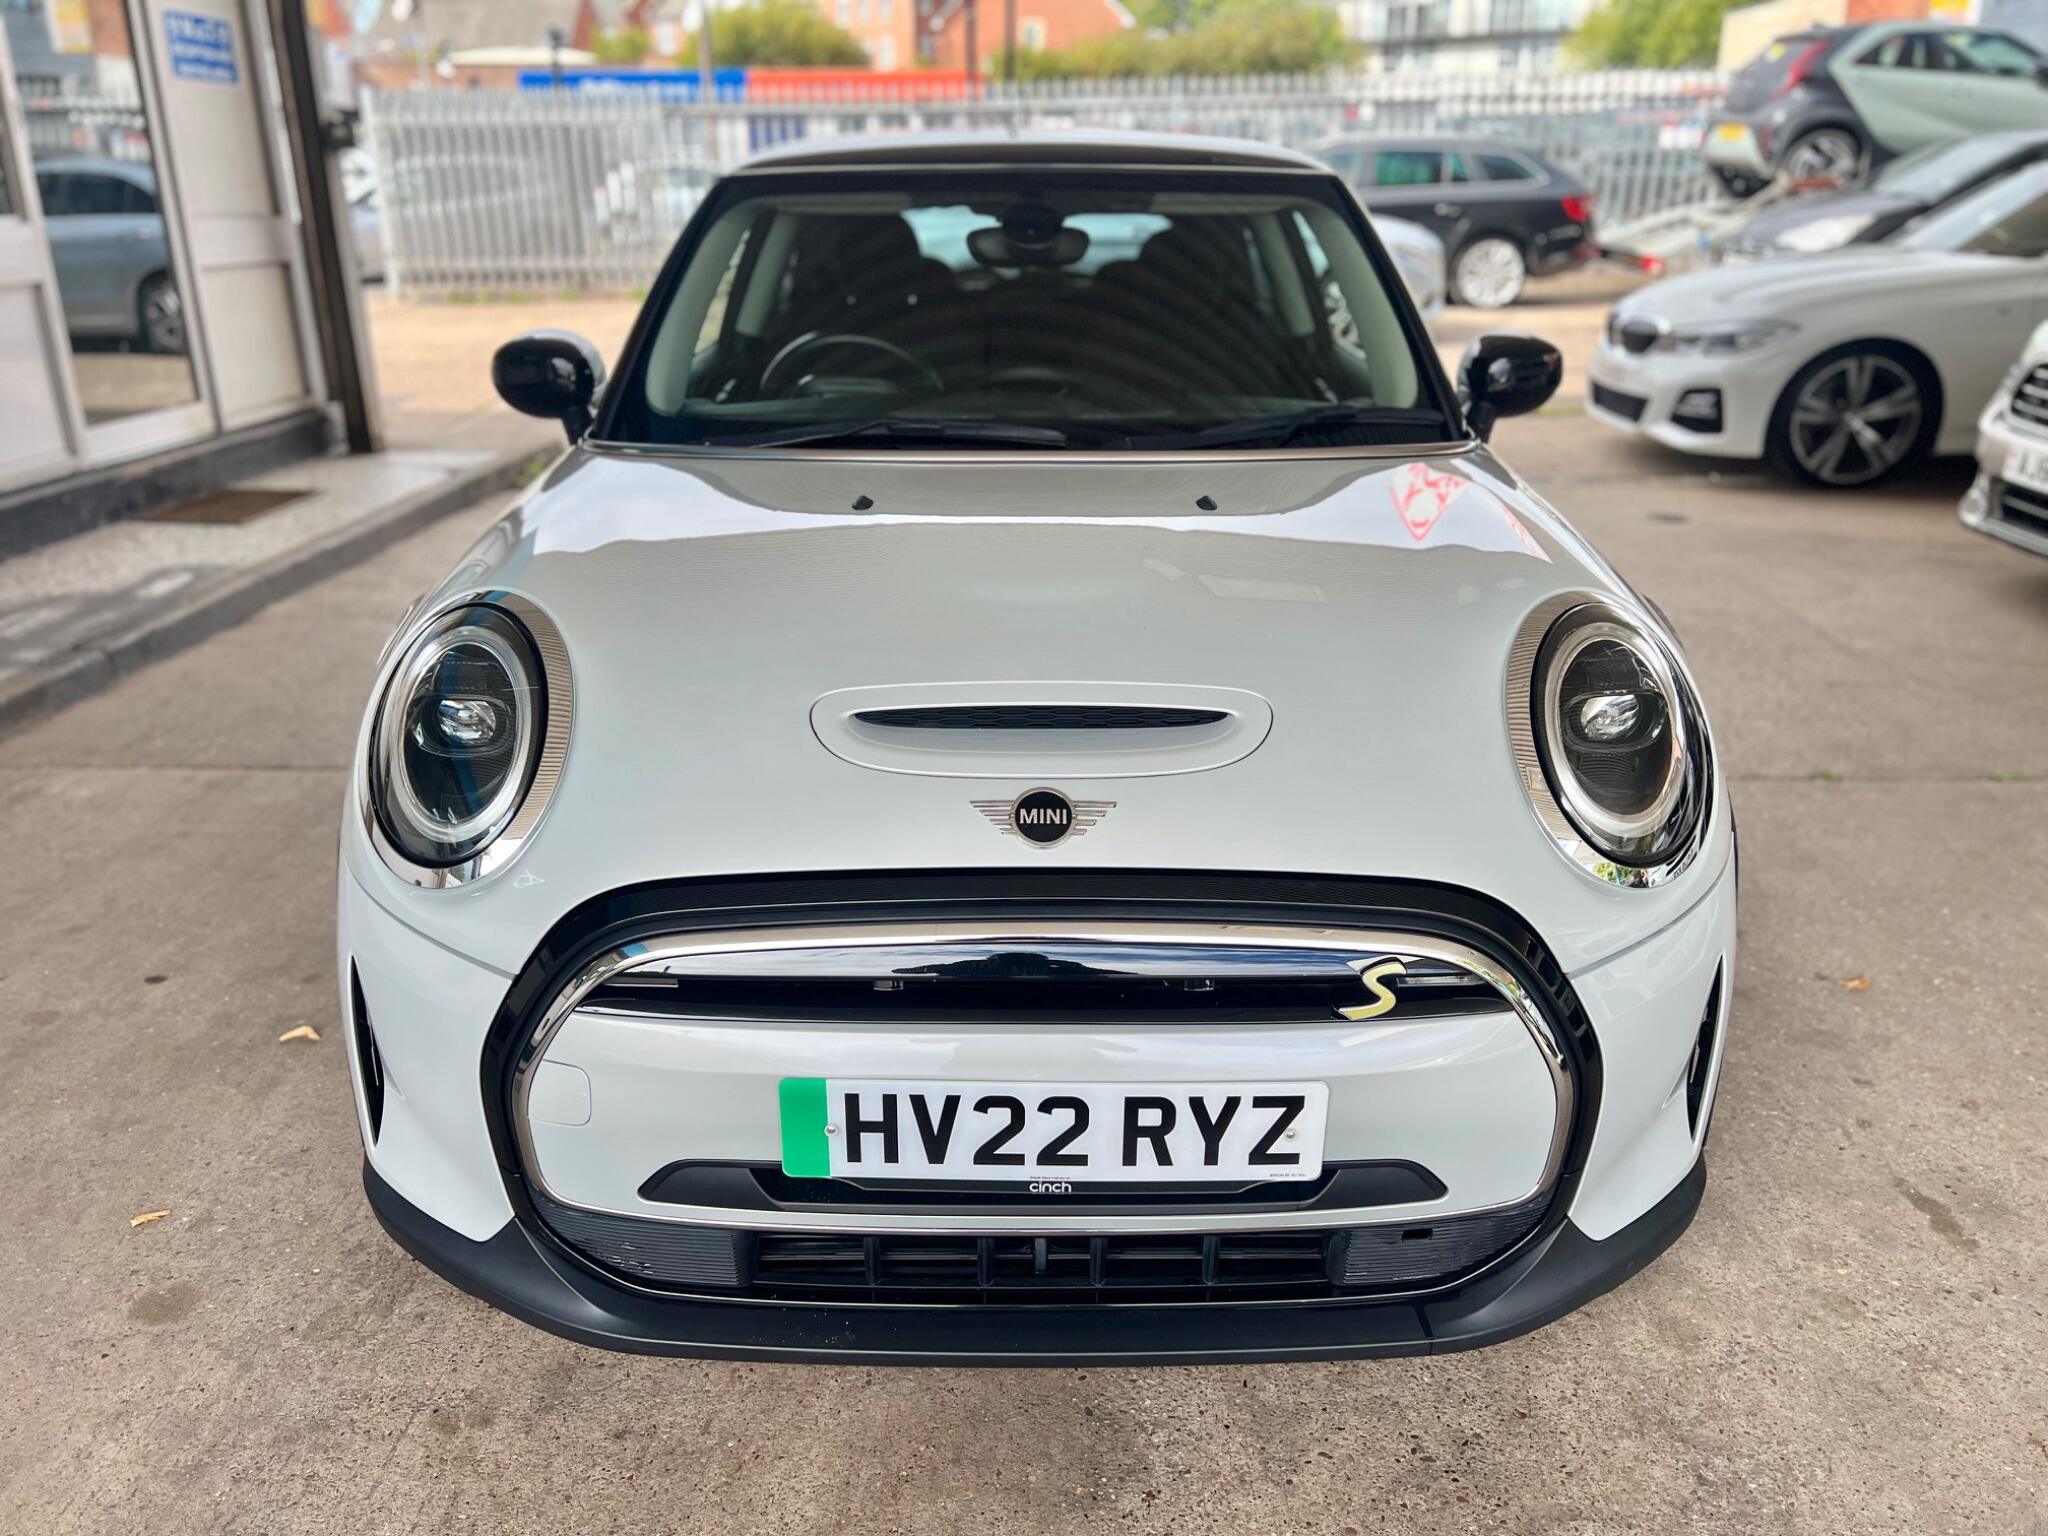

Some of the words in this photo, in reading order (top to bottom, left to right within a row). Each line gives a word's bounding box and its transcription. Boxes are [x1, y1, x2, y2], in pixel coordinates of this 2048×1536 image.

[1018, 808, 1068, 825] MINI
[1337, 960, 1408, 1021] S
[844, 1093, 1090, 1167] HV22
[1122, 1096, 1306, 1167] RYZ
[1029, 1181, 1072, 1193] cinch
